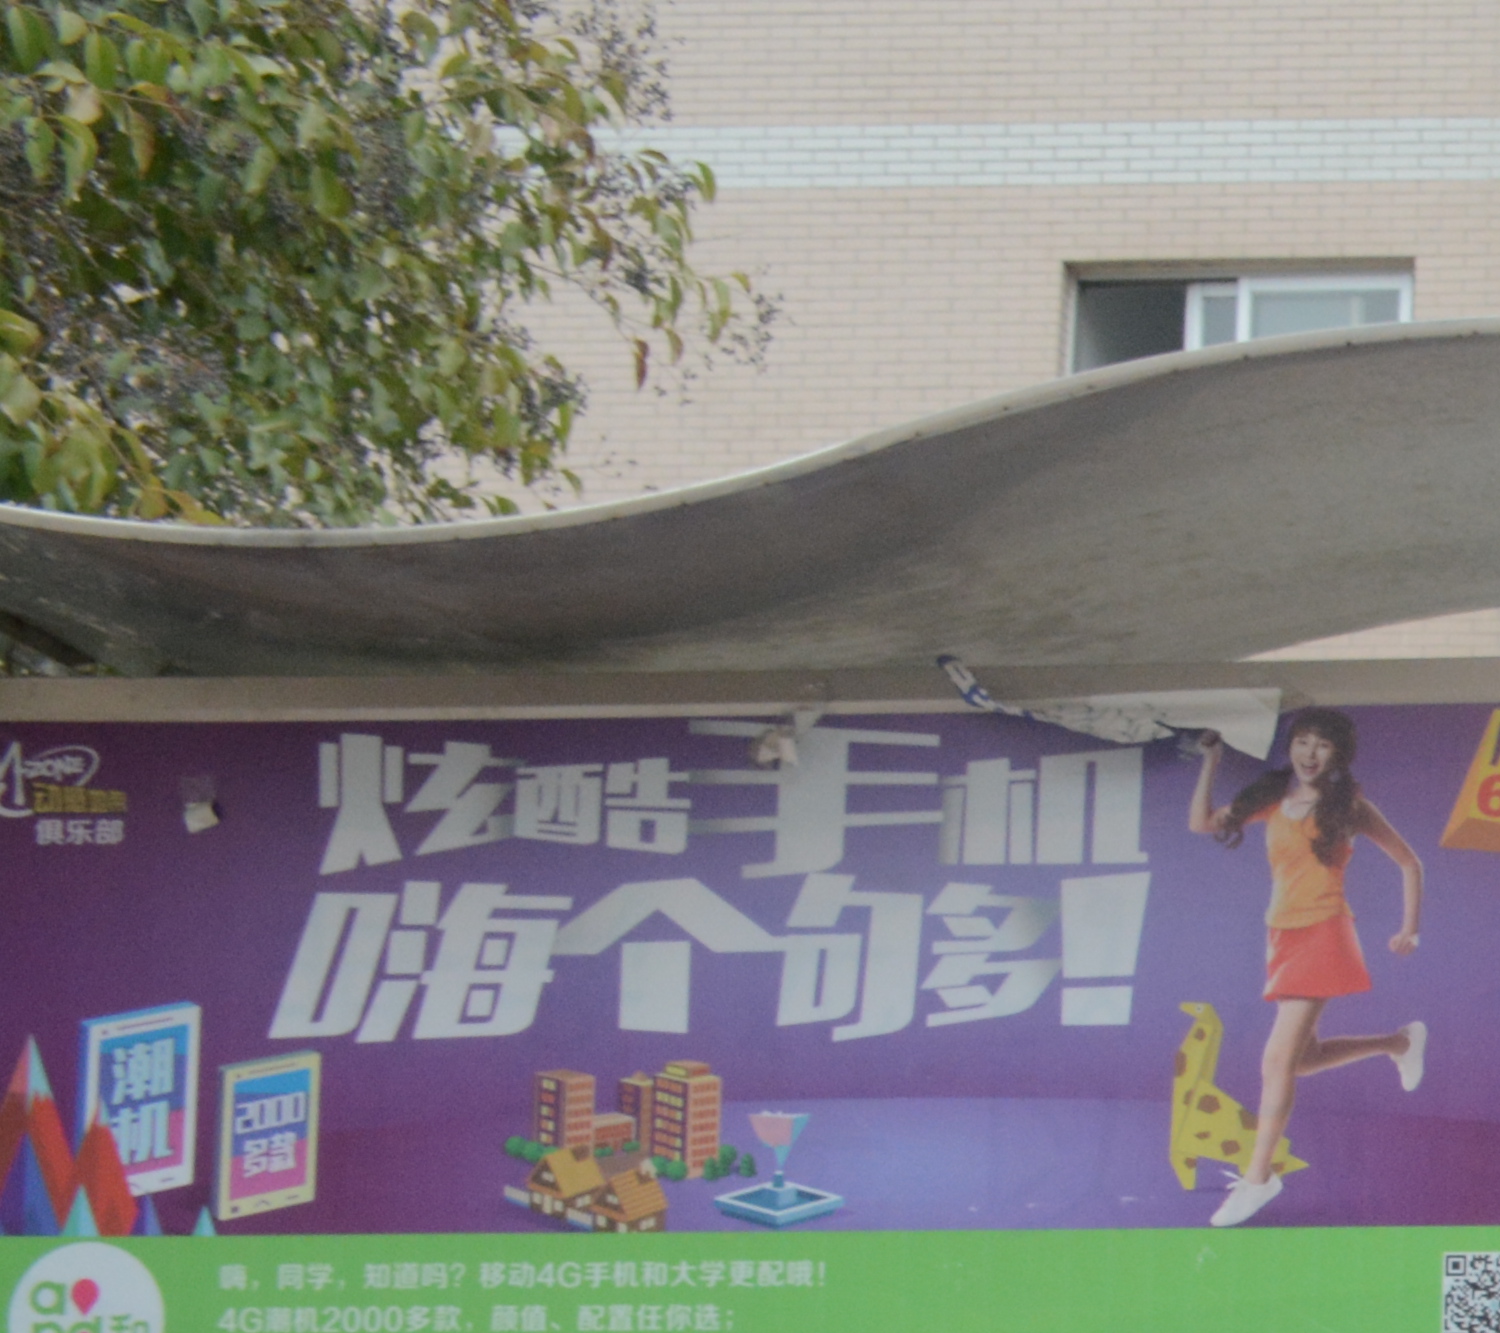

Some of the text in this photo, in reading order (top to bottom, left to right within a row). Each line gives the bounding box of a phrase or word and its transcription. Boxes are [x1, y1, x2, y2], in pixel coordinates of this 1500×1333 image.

[36, 819, 125, 846] 俱乐部
[318, 718, 1149, 879] 炫酷手机
